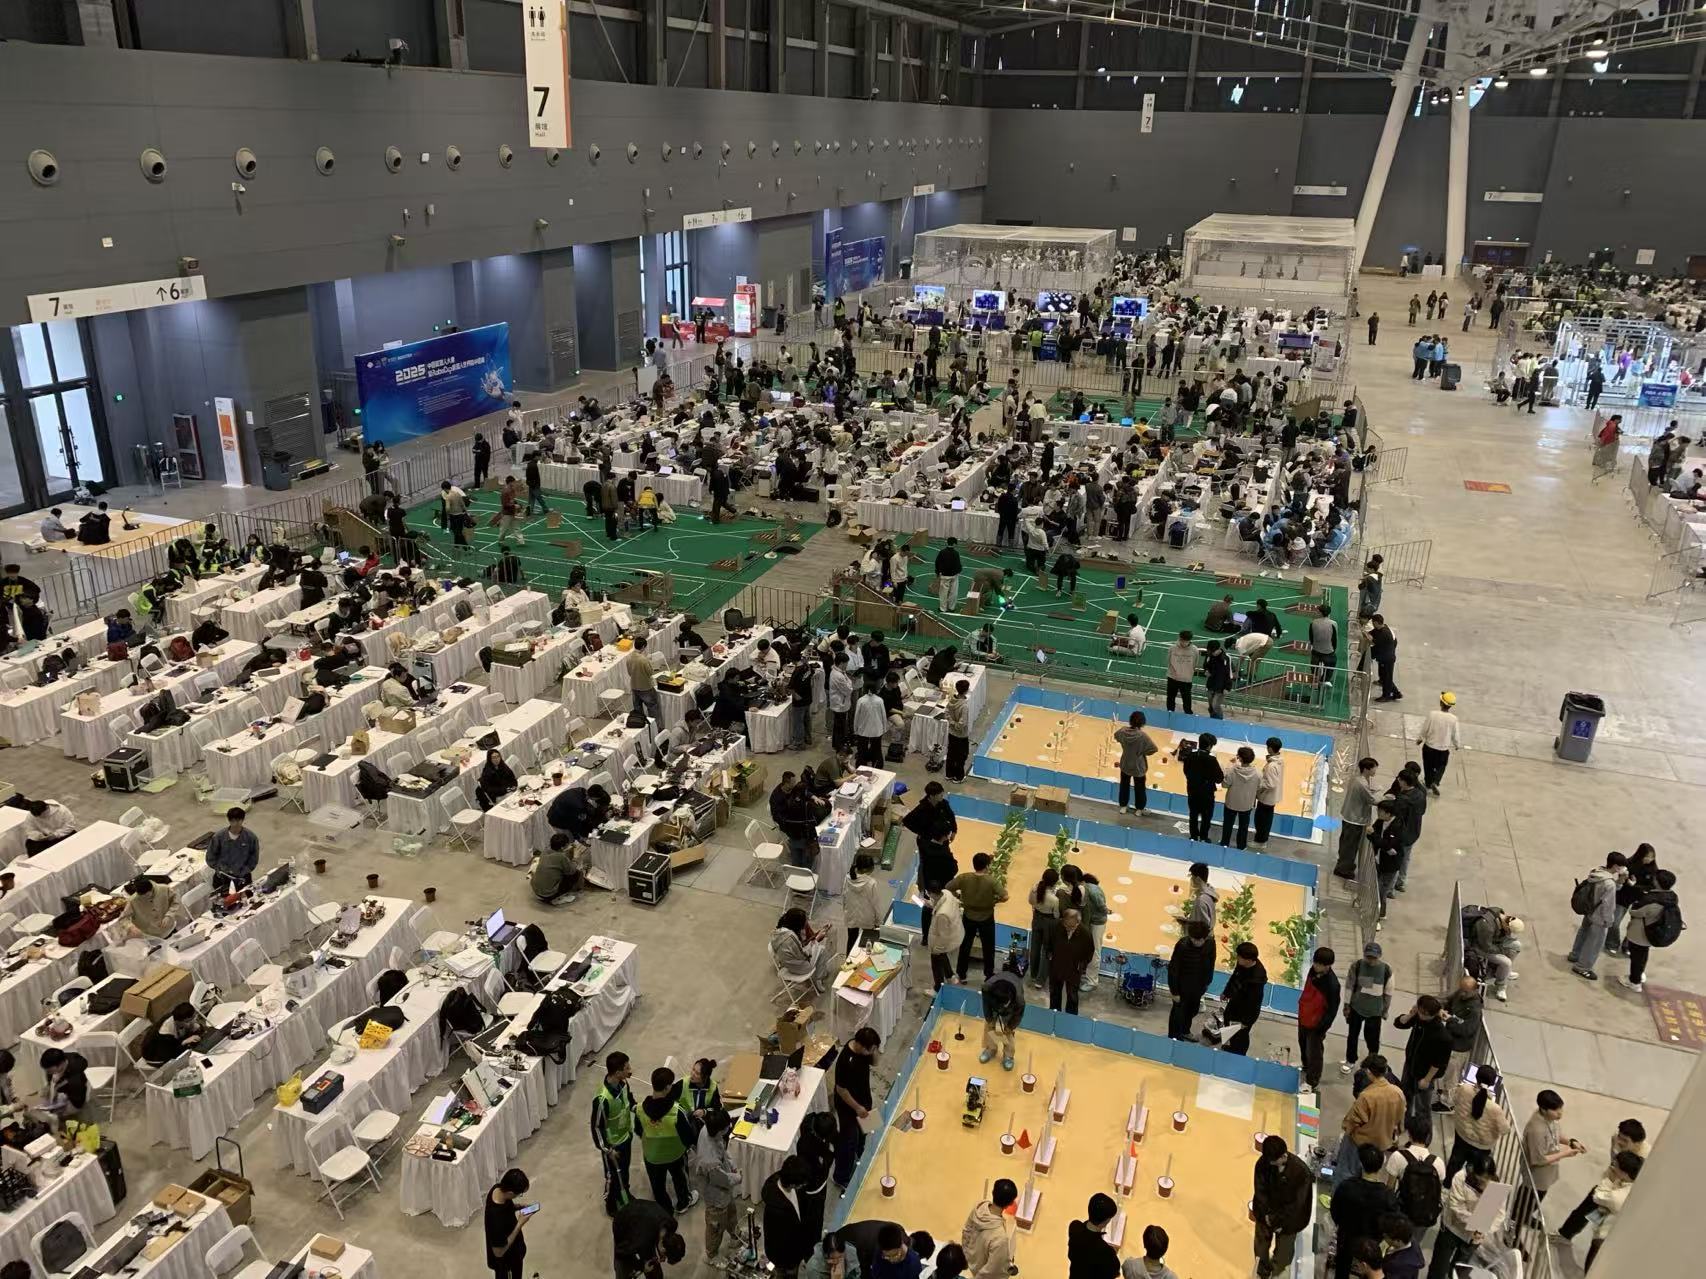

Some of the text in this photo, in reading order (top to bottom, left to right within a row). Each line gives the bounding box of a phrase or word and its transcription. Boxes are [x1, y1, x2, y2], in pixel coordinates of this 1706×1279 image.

[533, 86, 550, 117] 7
[1146, 116, 1151, 125] 7
[170, 282, 180, 300] 6
[48, 297, 60, 316] 7
[395, 363, 426, 382] 2025
